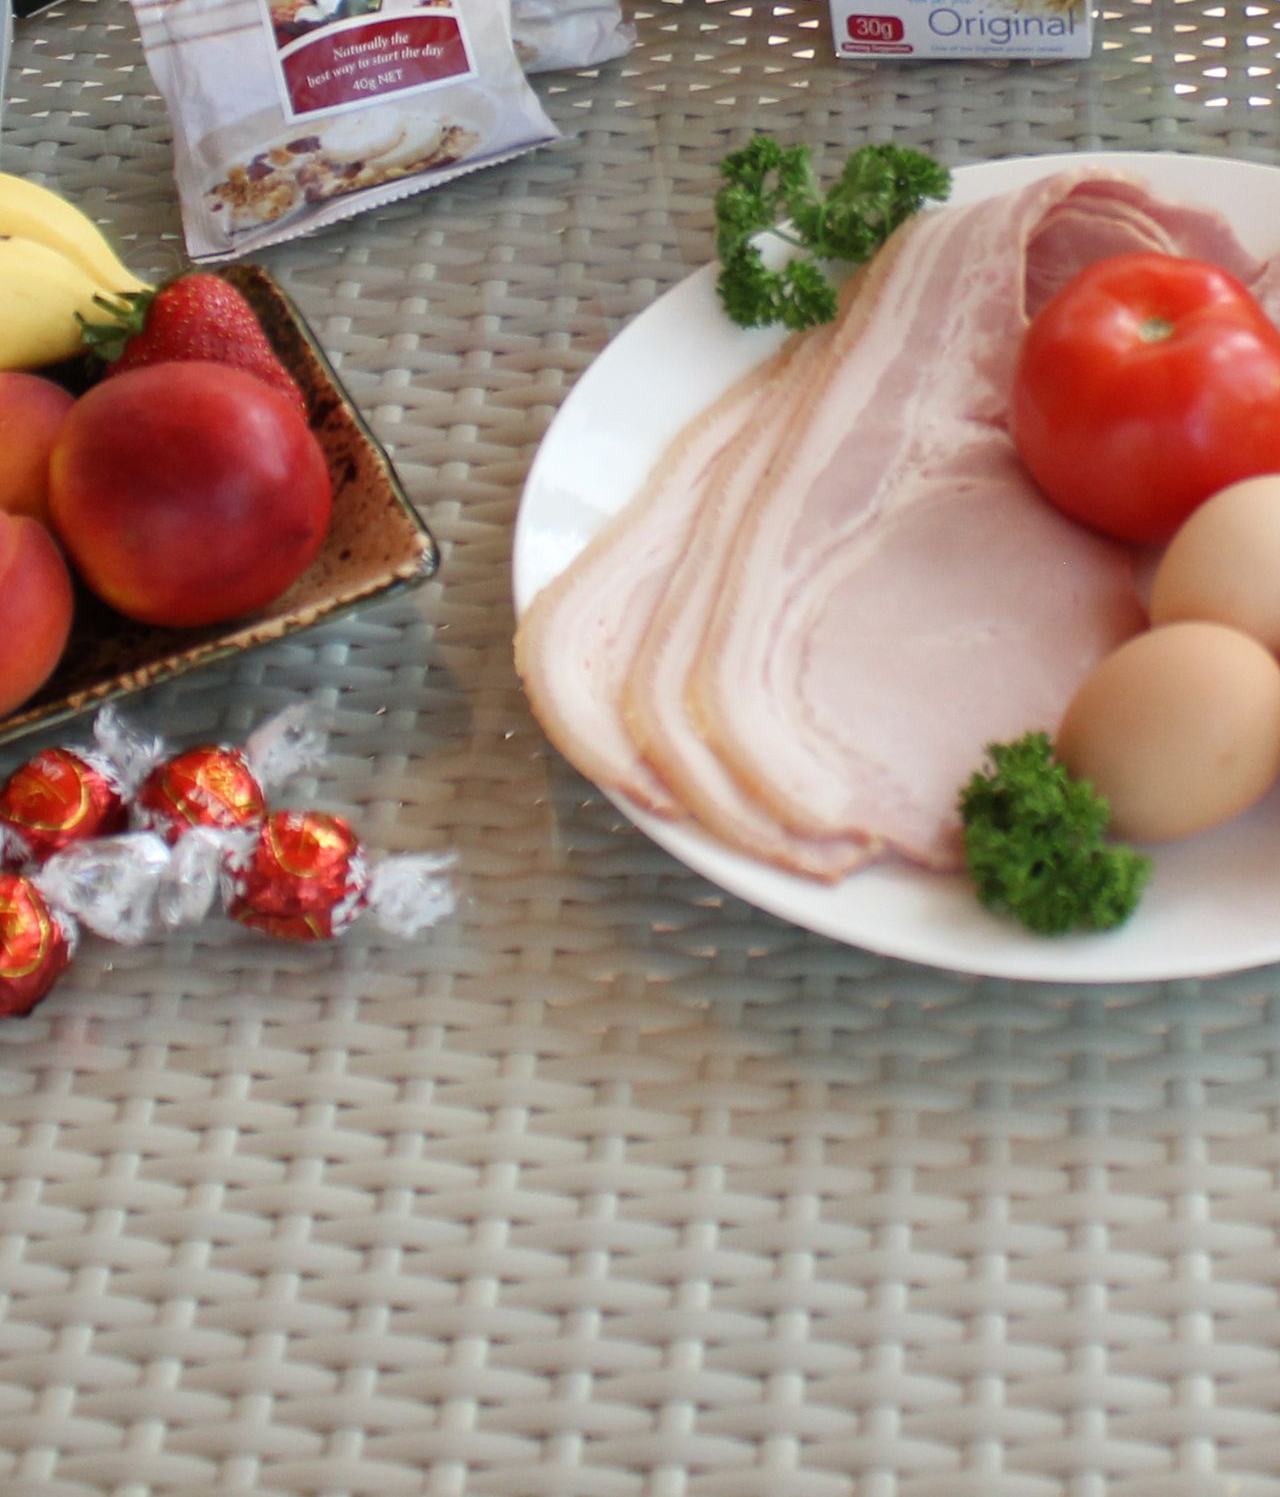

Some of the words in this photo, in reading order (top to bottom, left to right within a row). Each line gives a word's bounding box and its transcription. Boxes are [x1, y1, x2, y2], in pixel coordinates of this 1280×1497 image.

[856, 18, 894, 40] 30g
[928, 7, 1075, 45] Original
[333, 34, 389, 62] Naturally
[391, 32, 410, 45] the
[307, 69, 332, 89] best
[333, 62, 357, 77] way
[358, 56, 371, 69] to
[372, 51, 399, 66] start
[401, 46, 420, 59] the
[421, 43, 445, 59] day
[352, 75, 378, 91] 40g
[379, 68, 405, 84] NET
